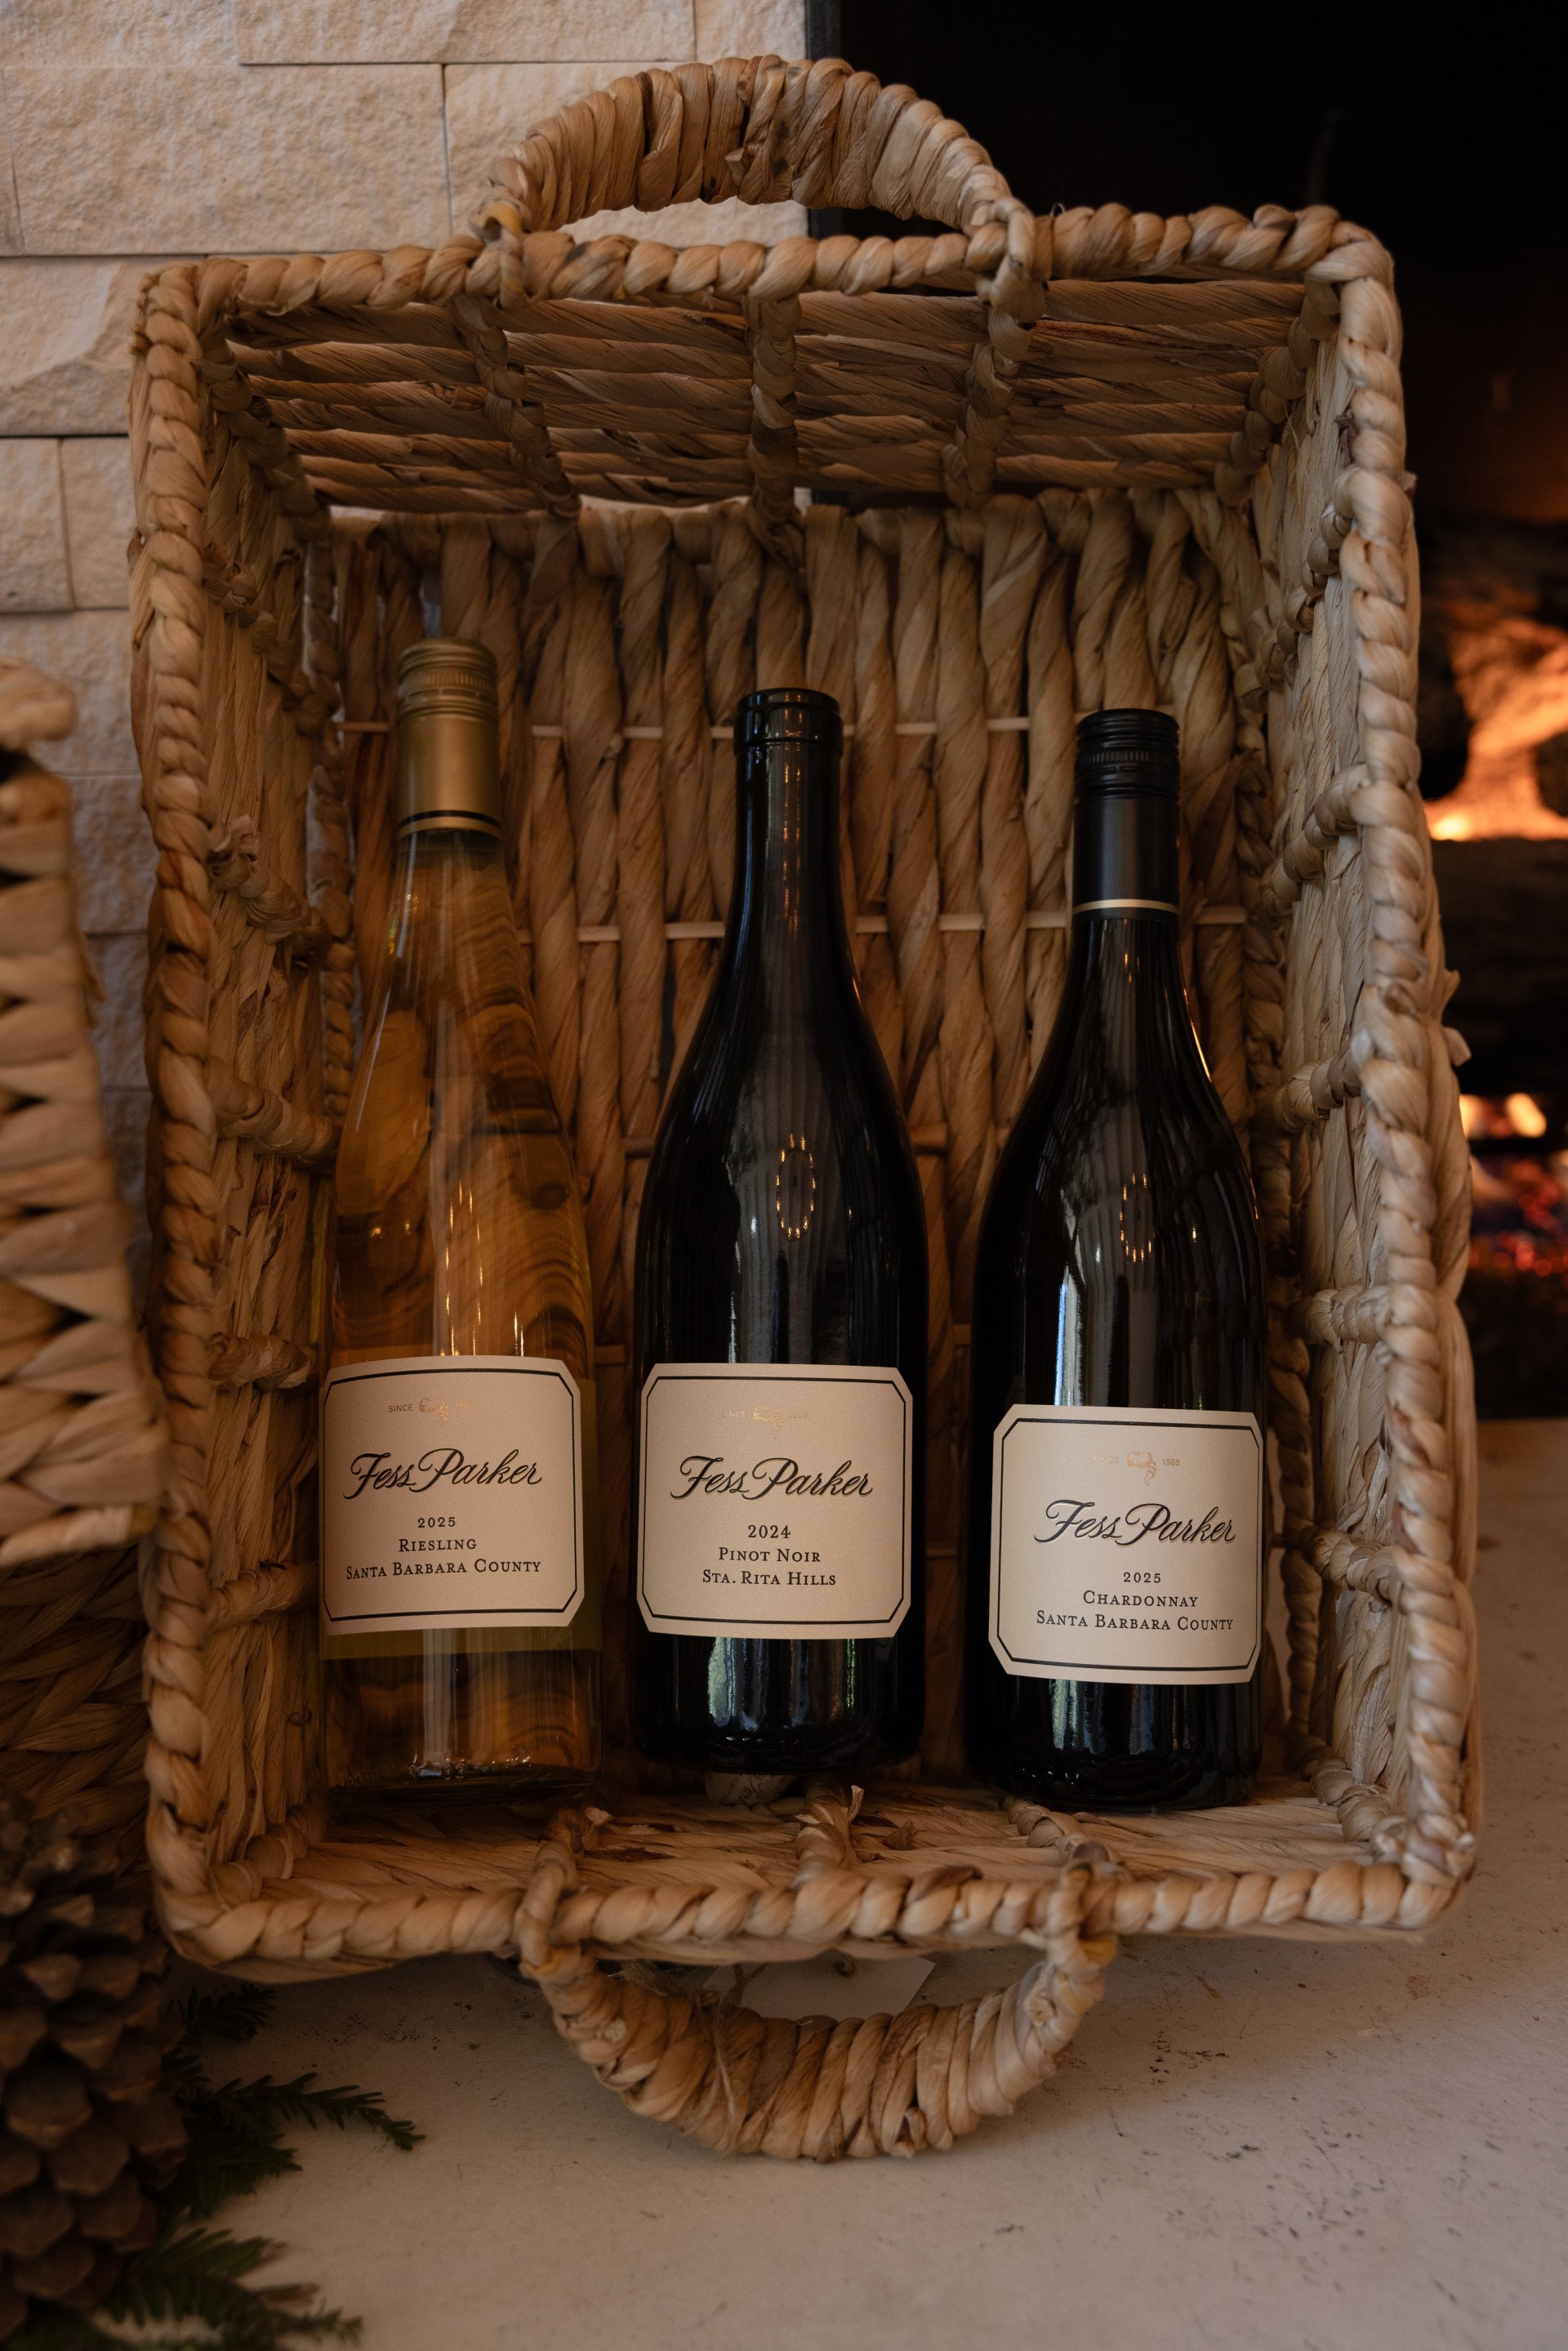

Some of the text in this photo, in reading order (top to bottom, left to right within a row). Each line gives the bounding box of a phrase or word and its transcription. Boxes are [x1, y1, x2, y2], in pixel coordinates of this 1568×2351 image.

[388, 1404, 413, 1412] SINCE
[1092, 1456, 1119, 1464] SINCE
[343, 1448, 542, 1500] Fess Parker
[670, 1456, 873, 1500] Fess Parker
[417, 1517, 456, 1528] 2025
[1034, 1499, 1236, 1546] Fess Parker
[747, 1524, 791, 1539] 2024
[399, 1539, 478, 1552] RIESLING
[719, 1547, 821, 1563] PINOT NOIR
[346, 1559, 541, 1580] SANTA BARBARA COUNTY
[702, 1569, 836, 1586] STA. RITA HILLS
[1123, 1573, 1161, 1583] 2025
[1083, 1590, 1199, 1608] CHARDONNAY
[1036, 1611, 1234, 1631] SANTA BARBARA COUNTY
